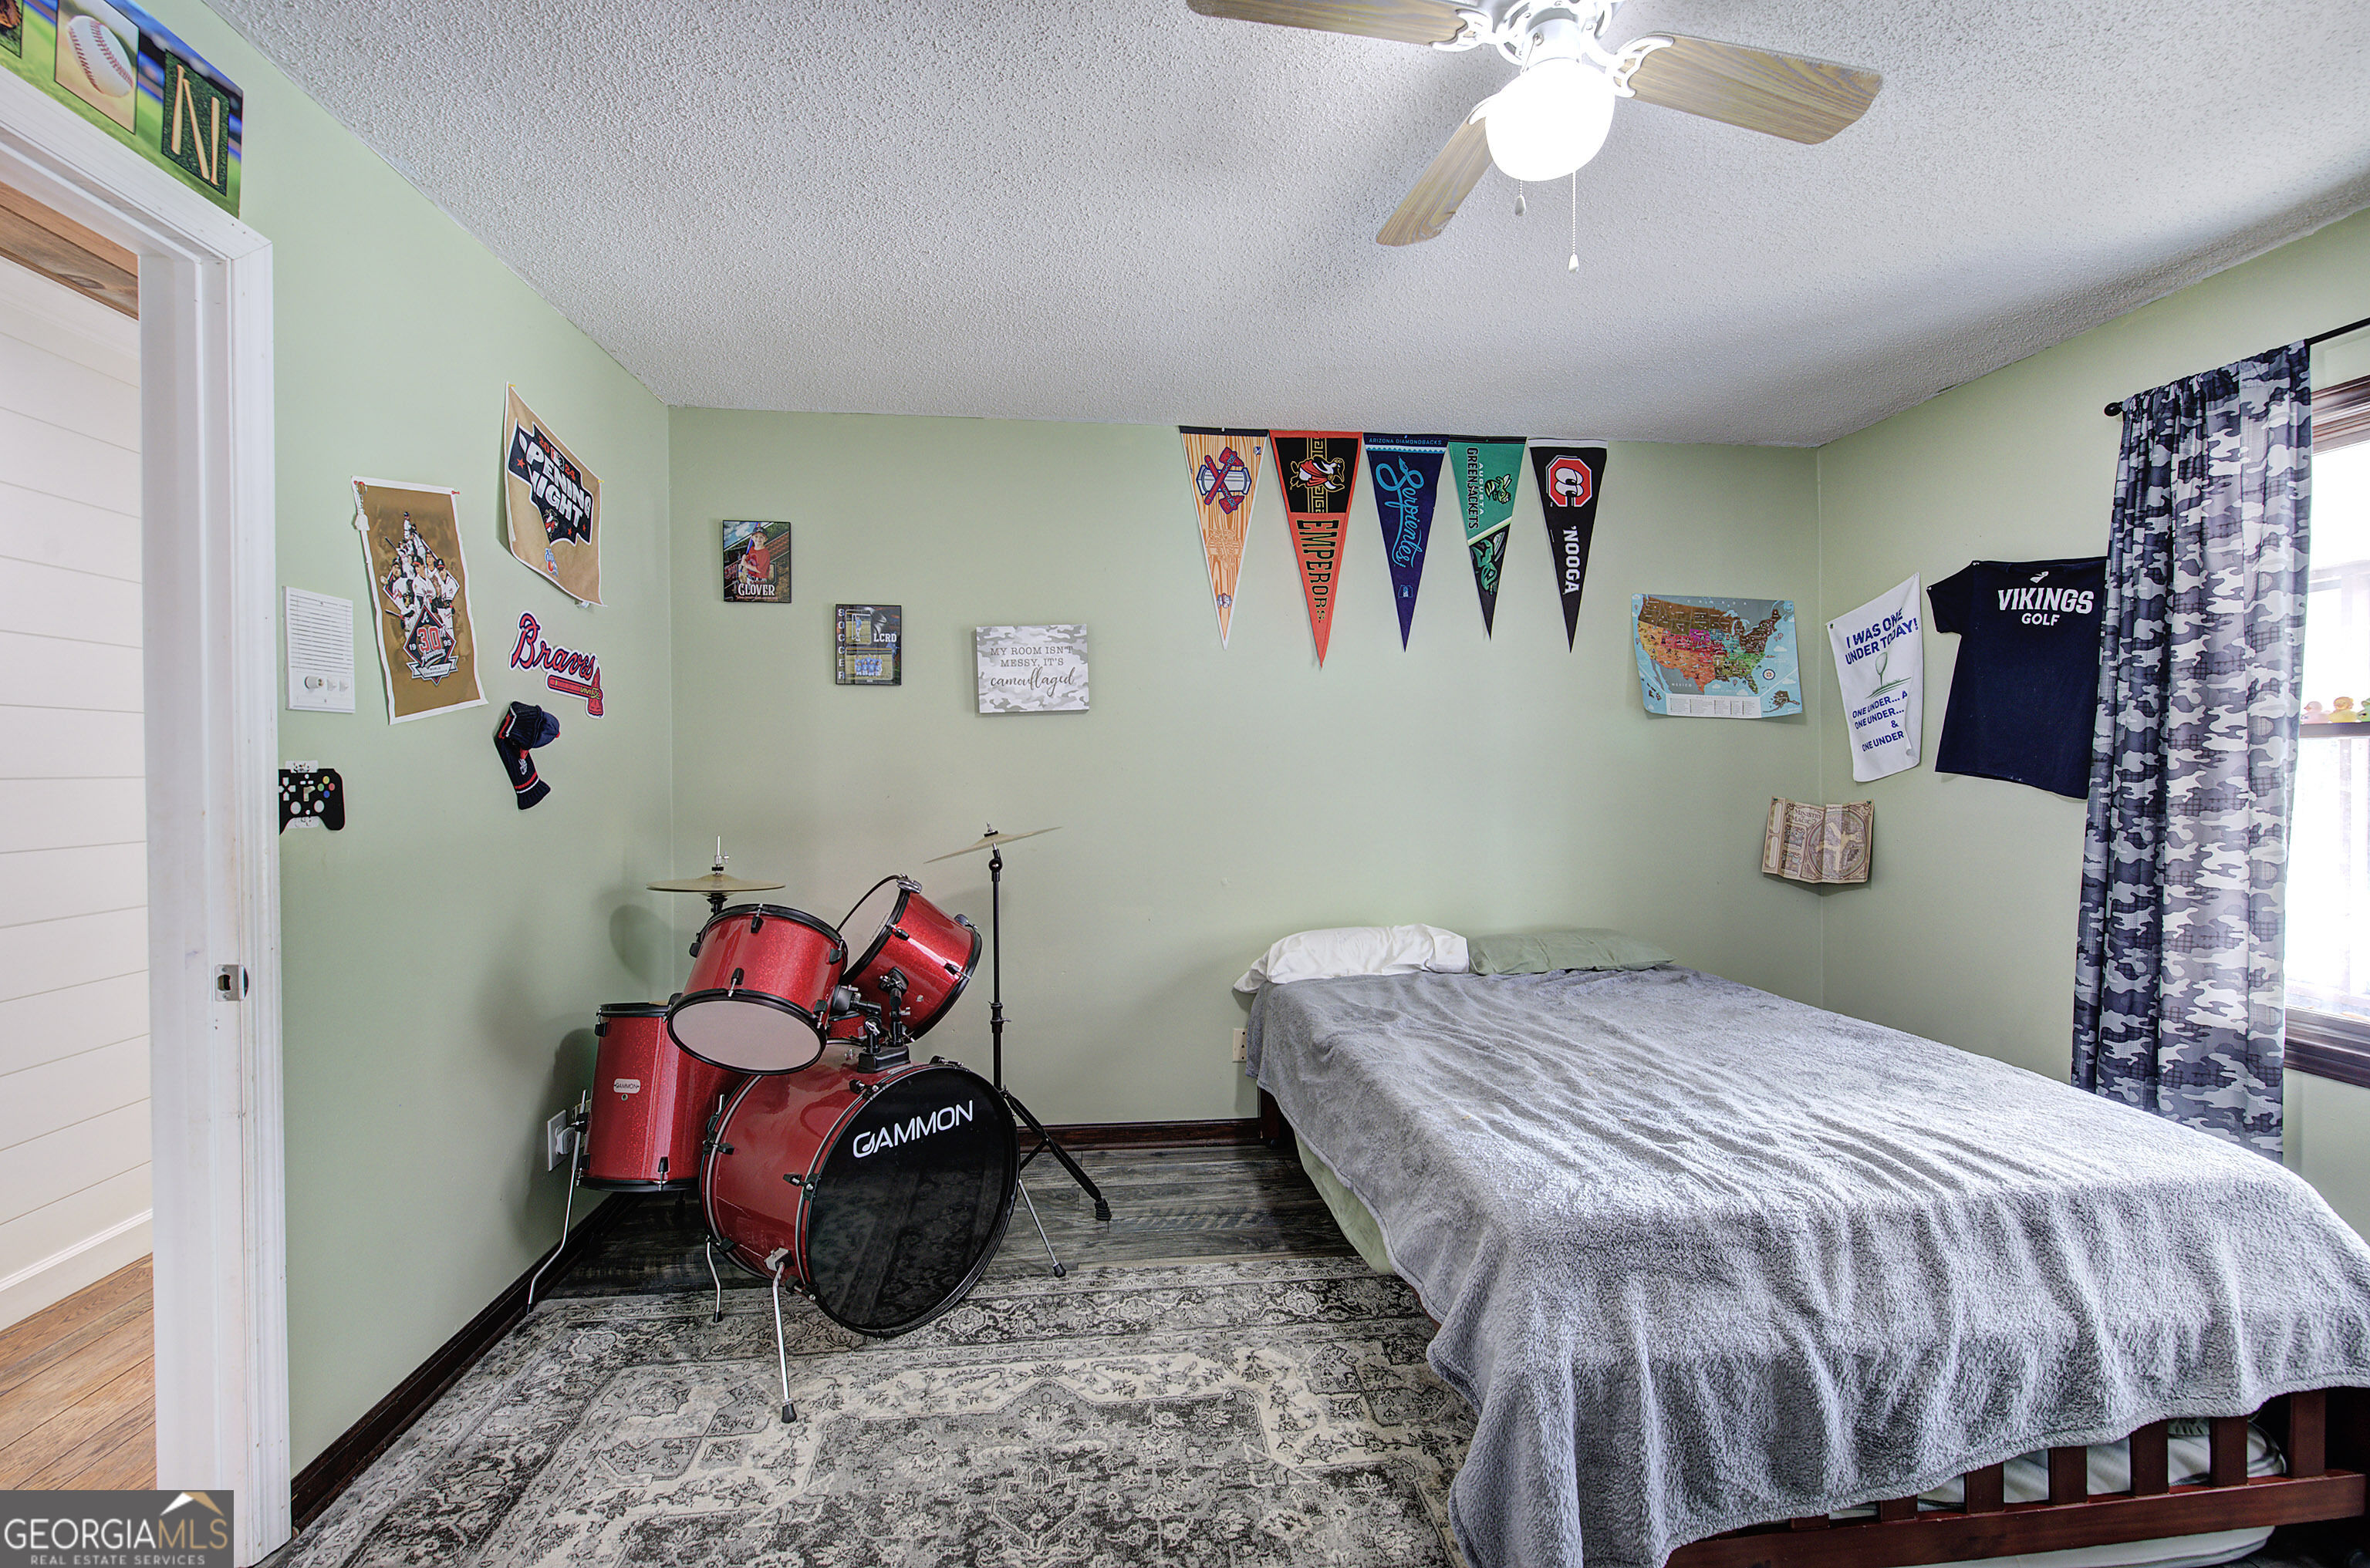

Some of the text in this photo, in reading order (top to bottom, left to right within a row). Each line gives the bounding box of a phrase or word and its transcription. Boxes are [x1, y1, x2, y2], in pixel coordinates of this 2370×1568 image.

[1296, 519, 1339, 623] EMPERORS
[738, 583, 775, 596] GLOVER
[1997, 587, 2095, 615] VIKINGS
[2021, 612, 2060, 626] GOLF
[1846, 607, 1903, 649] I WAS ONE
[873, 633, 897, 642] LCRD
[1845, 617, 1919, 665] UNDER TODAY!
[511, 612, 596, 681] Braves
[991, 645, 1074, 656] MY ROOM ISN'T
[1001, 657, 1064, 668] MESSY, IT'S
[990, 666, 1076, 697] camouflaged
[1852, 706, 1866, 718] ONE
[1855, 718, 1867, 730] ONE
[1890, 720, 1899, 728] &
[1873, 730, 1904, 747] UNDER
[852, 1100, 973, 1158] GAMMON
